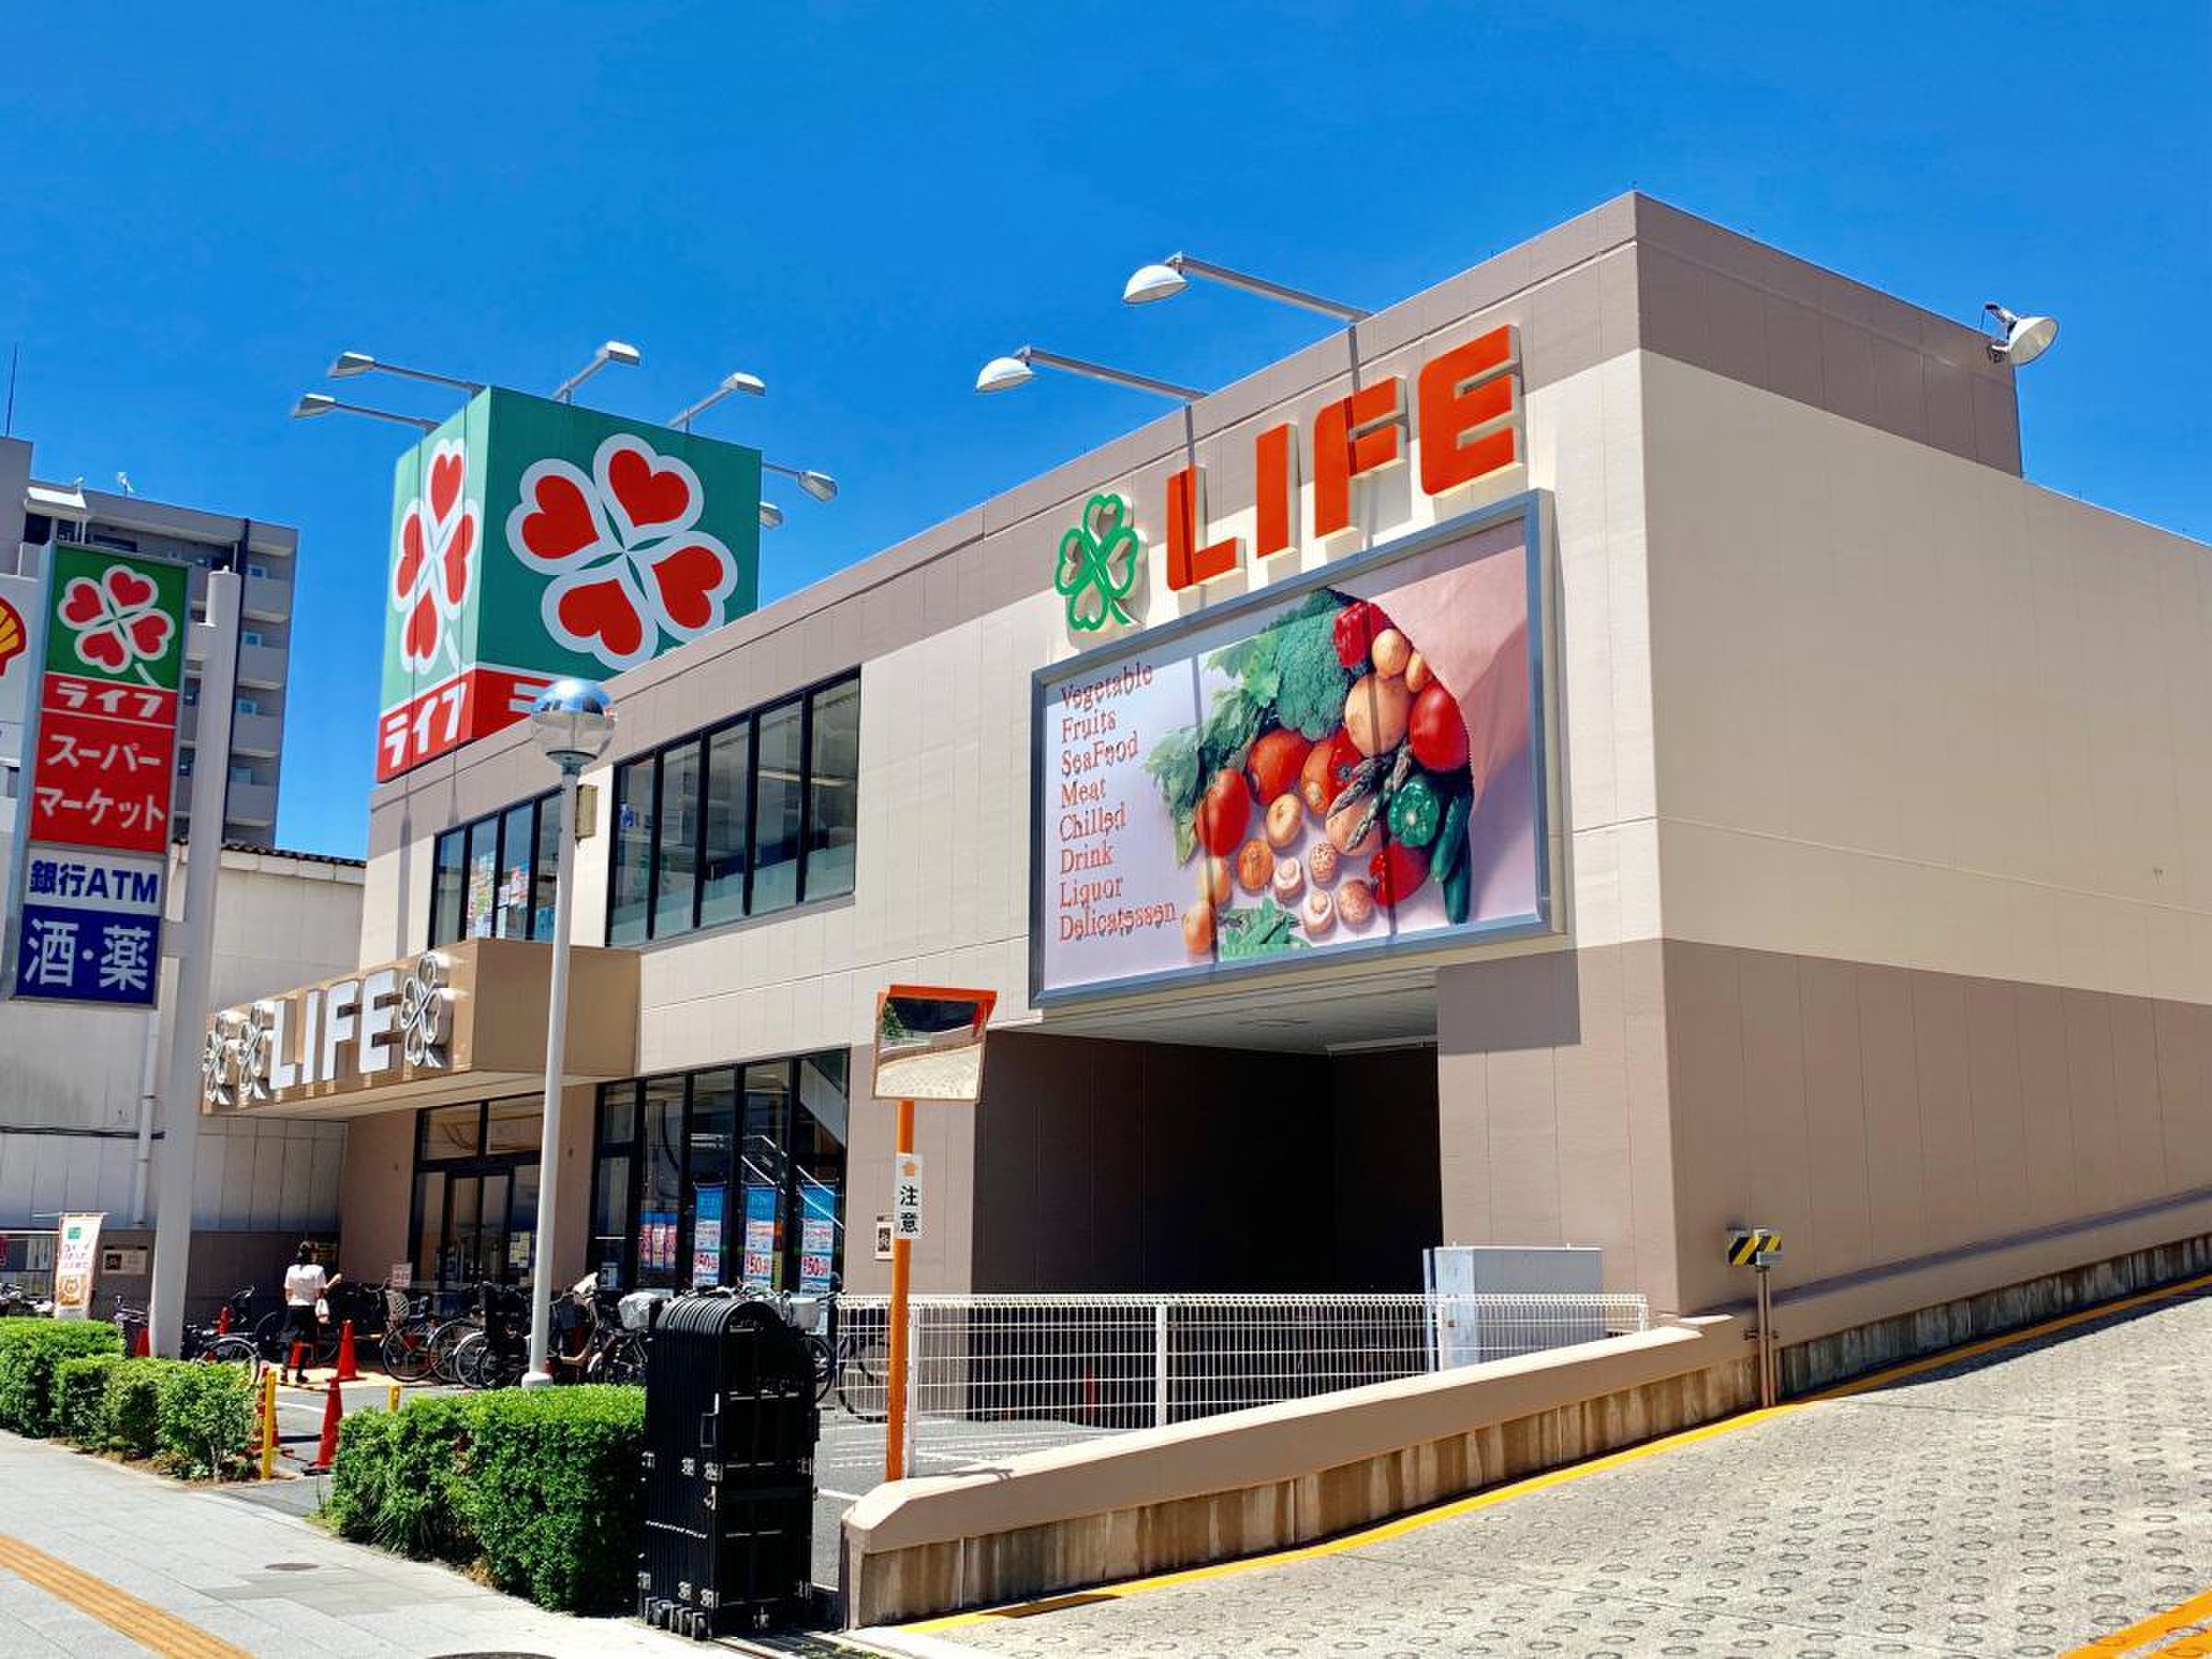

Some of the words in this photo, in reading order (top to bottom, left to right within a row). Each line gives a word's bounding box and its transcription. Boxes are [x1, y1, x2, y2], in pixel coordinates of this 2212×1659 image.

[1168, 324, 1524, 591] LIFE
[56, 684, 163, 717] ライフ
[1061, 662, 1152, 712] Vegetable
[384, 682, 468, 767] ライフ
[1062, 709, 1117, 744] Fruits
[46, 735, 162, 772] スーパー
[1061, 731, 1138, 778] SeaFood
[35, 786, 165, 831] マーケット
[1061, 779, 1106, 808] Meat
[1060, 801, 1127, 841] Chilled
[1061, 840, 1114, 875] Drink
[29, 859, 158, 903] 銀行ATM
[1061, 877, 1124, 908] Liquor
[1061, 901, 1177, 941] Delicatessen
[24, 917, 151, 992] 酒・薬
[269, 969, 397, 1090] LIFE
[900, 1184, 919, 1233] 注意
